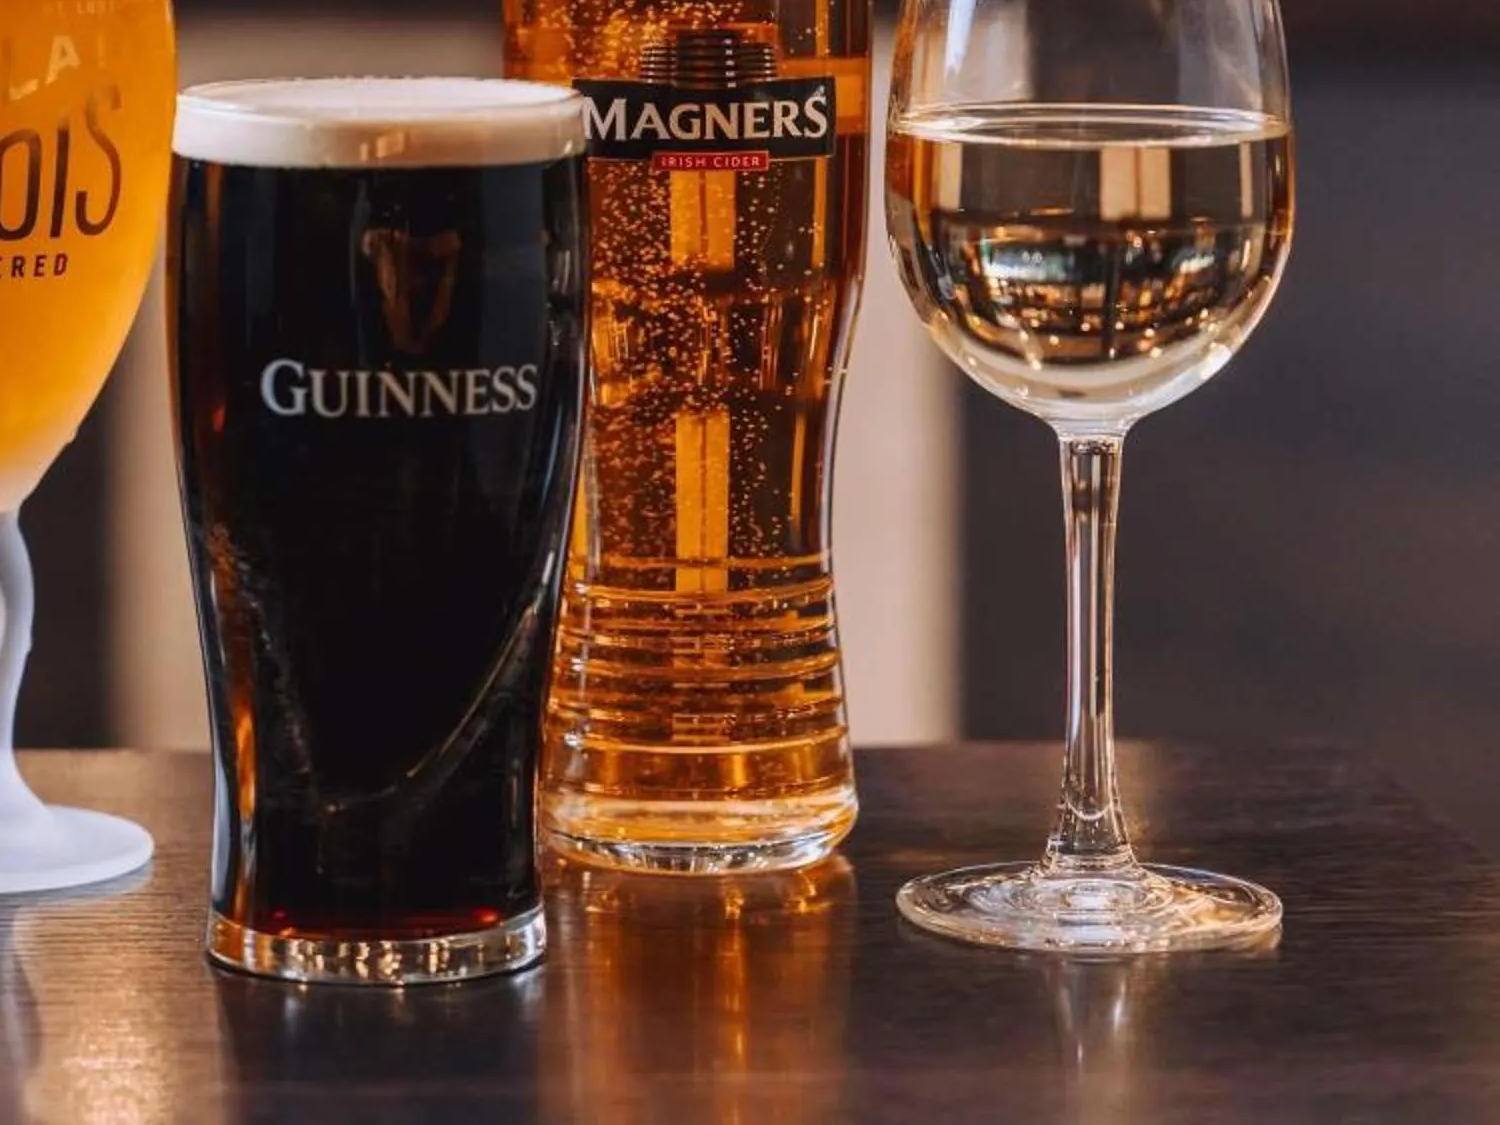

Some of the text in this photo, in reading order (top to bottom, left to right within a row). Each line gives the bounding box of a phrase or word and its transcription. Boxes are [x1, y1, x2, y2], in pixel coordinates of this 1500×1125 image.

[581, 96, 829, 141] MAGNERS
[661, 154, 760, 168] IRISH CIDER
[260, 358, 539, 419] GUINNESS
